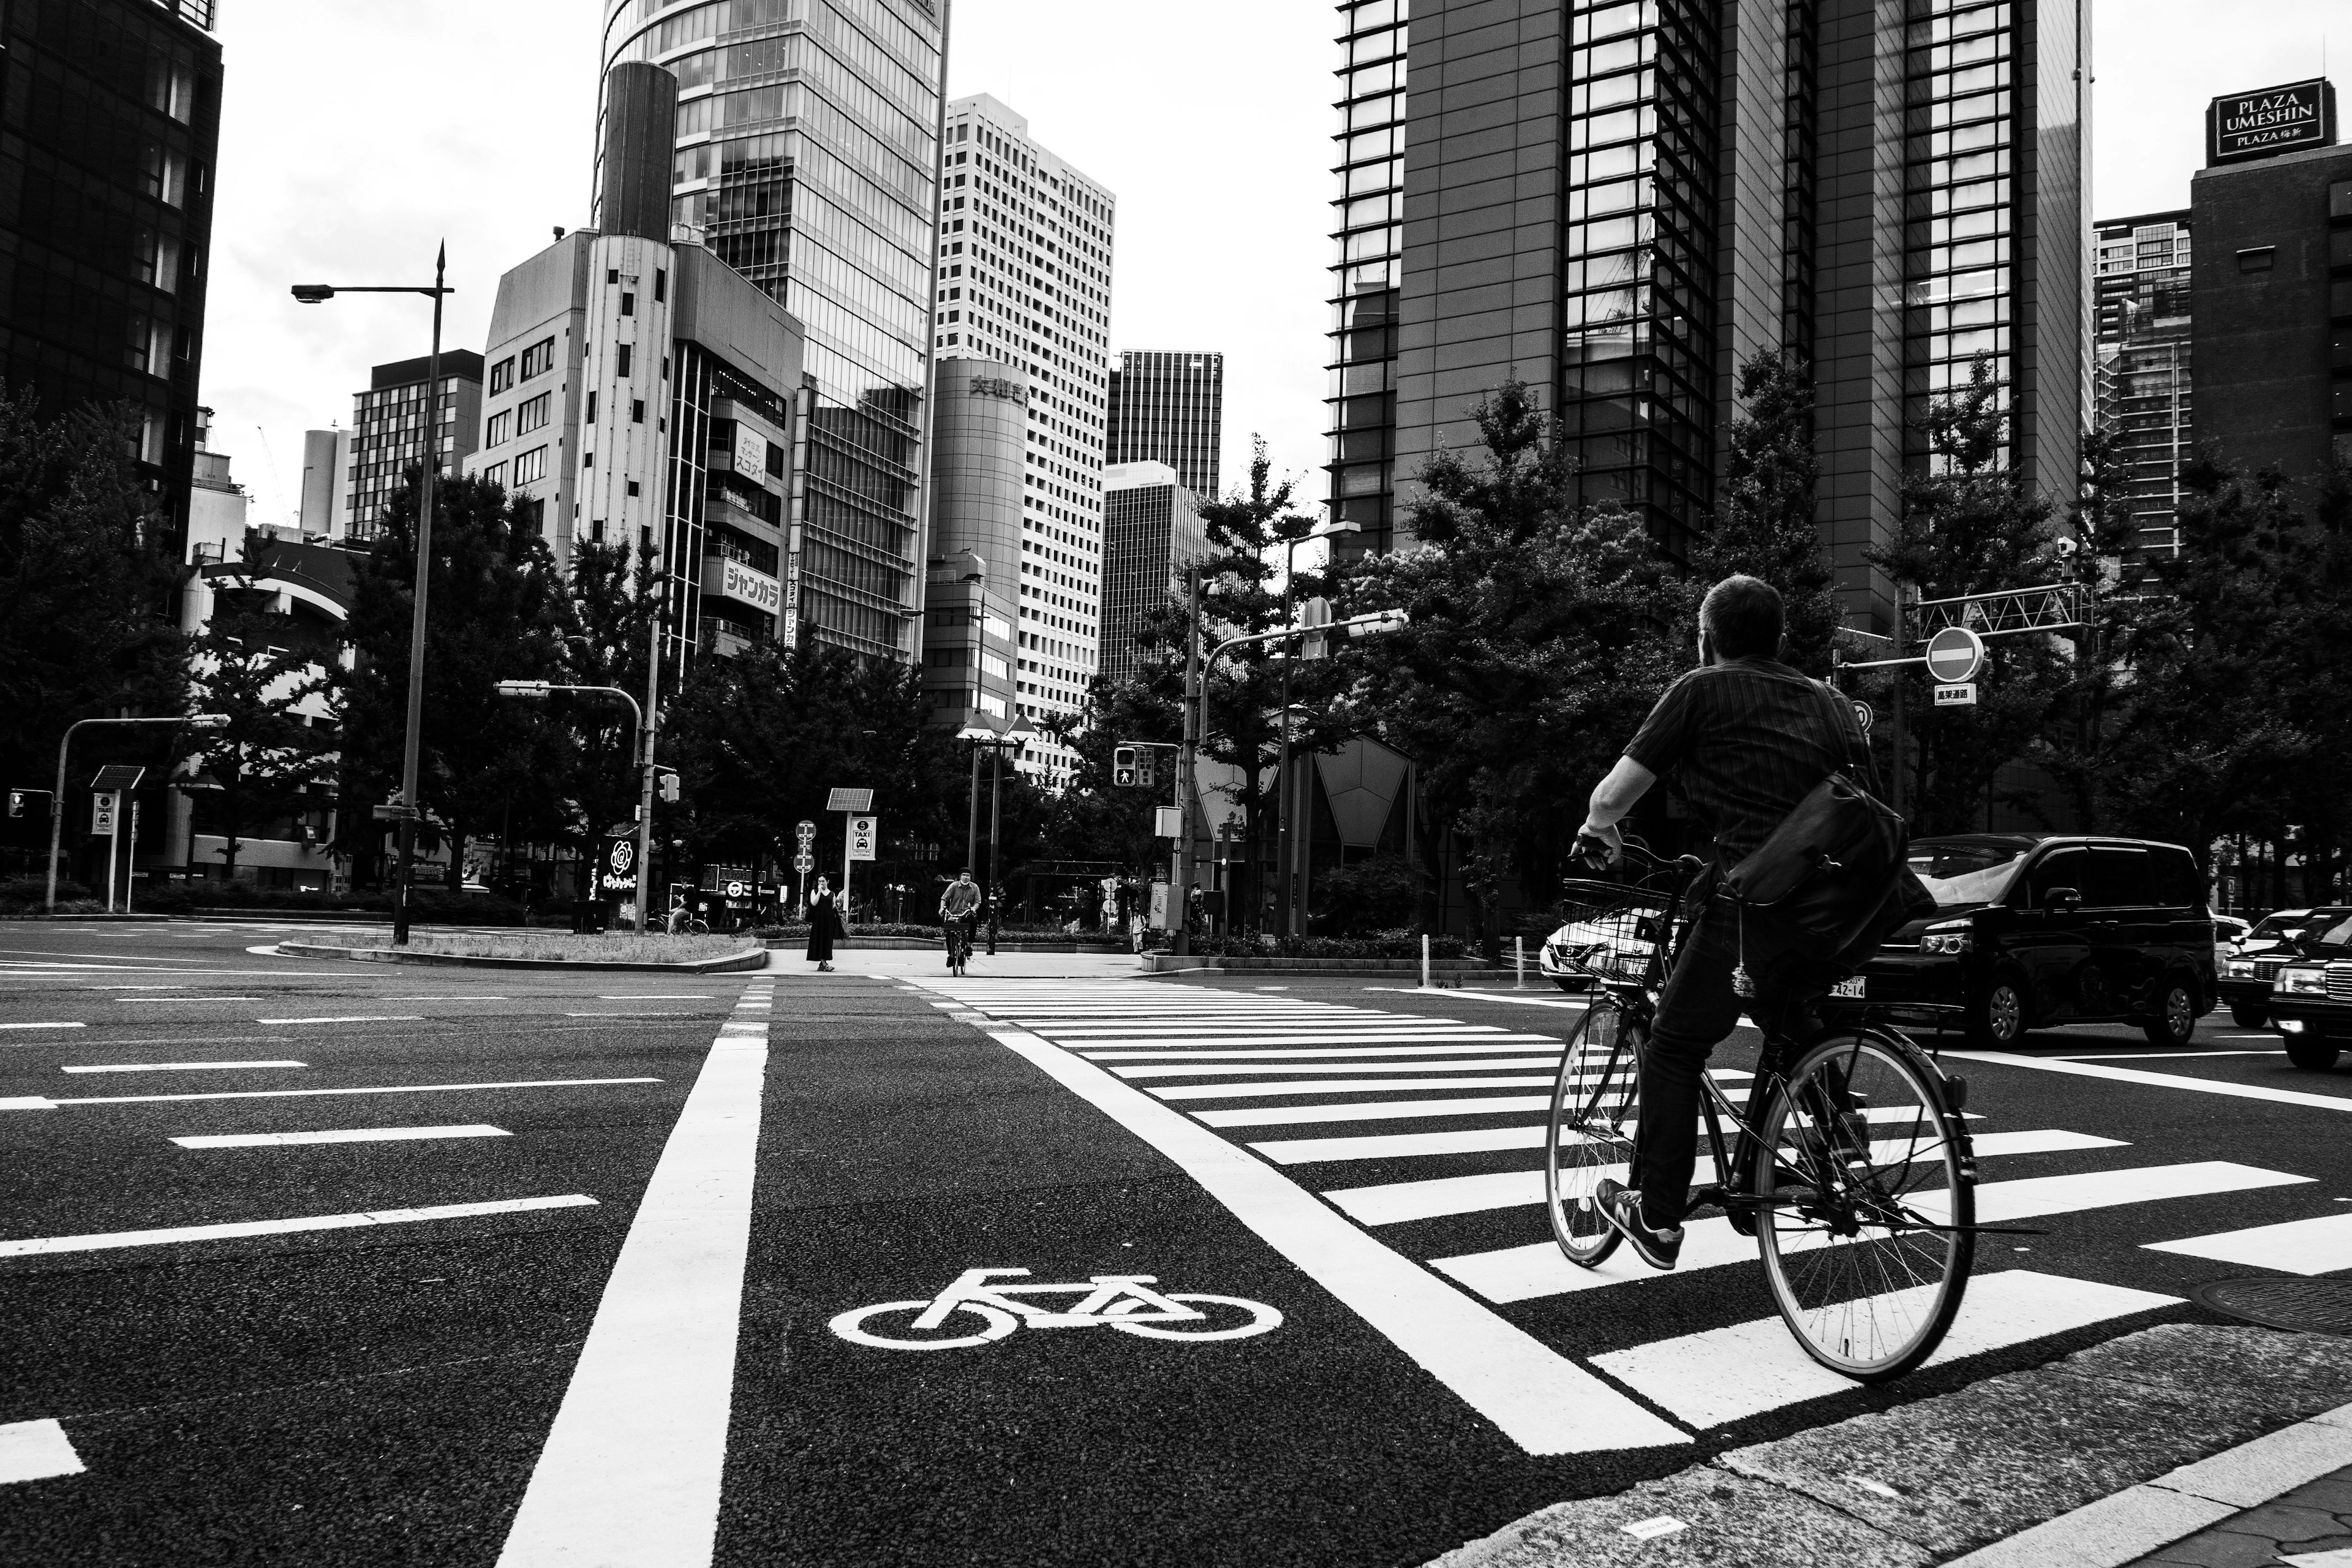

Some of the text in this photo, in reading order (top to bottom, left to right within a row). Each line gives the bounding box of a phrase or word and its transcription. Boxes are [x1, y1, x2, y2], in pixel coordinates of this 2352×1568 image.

[2239, 92, 2300, 115] PLAZA
[2226, 104, 2313, 131] UMESHIN
[2237, 132, 2278, 147] PLAZA
[744, 437, 760, 453] タイ古式
[741, 447, 761, 462] マッサージ
[736, 456, 764, 480] スコタイ
[728, 567, 778, 607] ジャンカラ
[1937, 689, 1968, 700] 高架道路
[1836, 985, 1864, 997] 42-14
